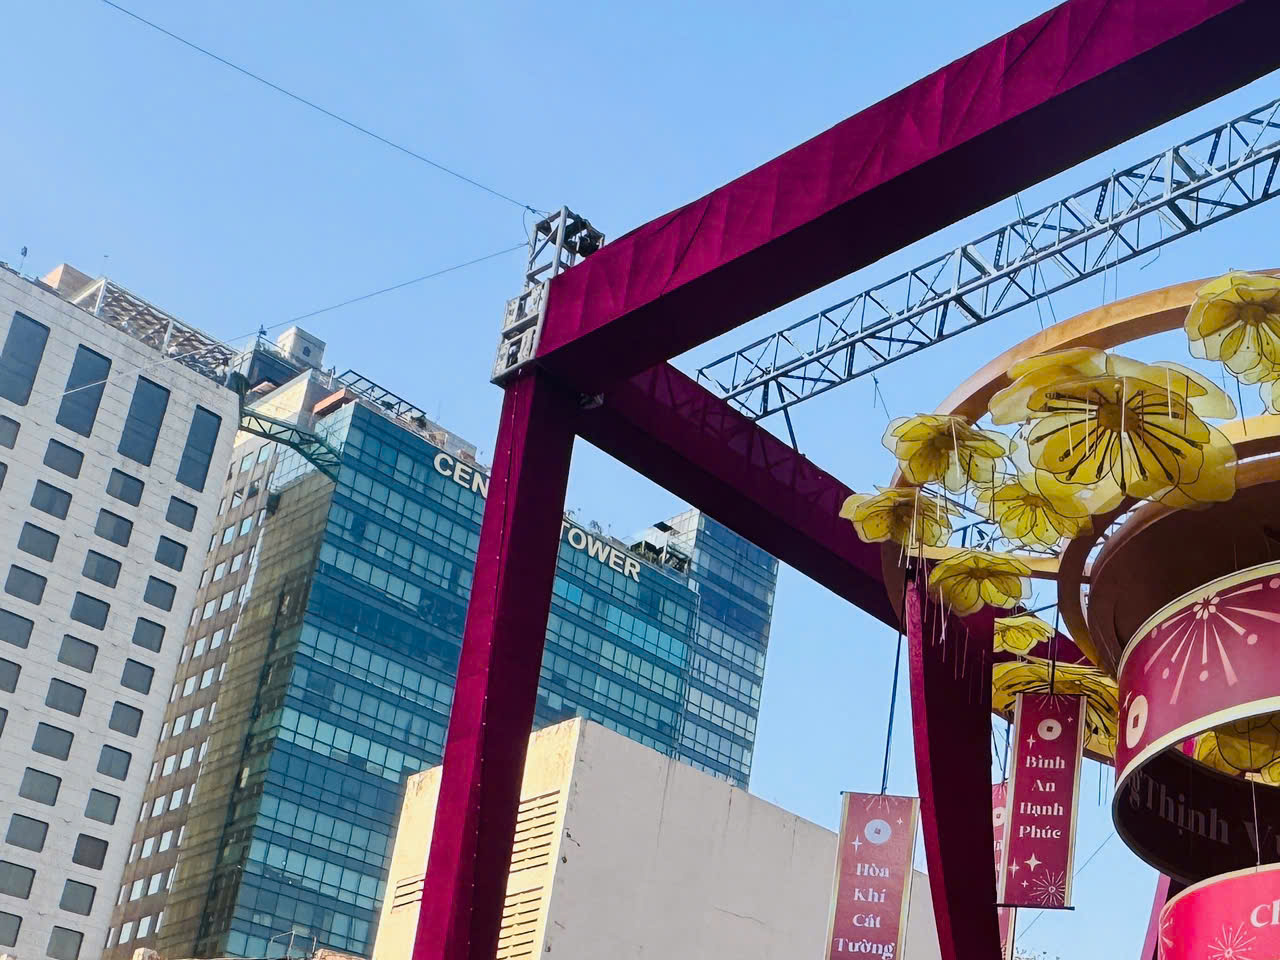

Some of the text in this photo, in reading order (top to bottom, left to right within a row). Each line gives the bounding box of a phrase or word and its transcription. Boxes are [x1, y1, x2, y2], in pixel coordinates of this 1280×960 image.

[1026, 755, 1065, 769] Bình
[1031, 779, 1055, 792] An
[1020, 802, 1064, 816] Hạnh
[1019, 825, 1062, 838] Phúc
[856, 863, 889, 878] Hòa
[854, 888, 886, 903] Khí
[853, 914, 881, 928] Cát
[834, 938, 895, 960] Tường
